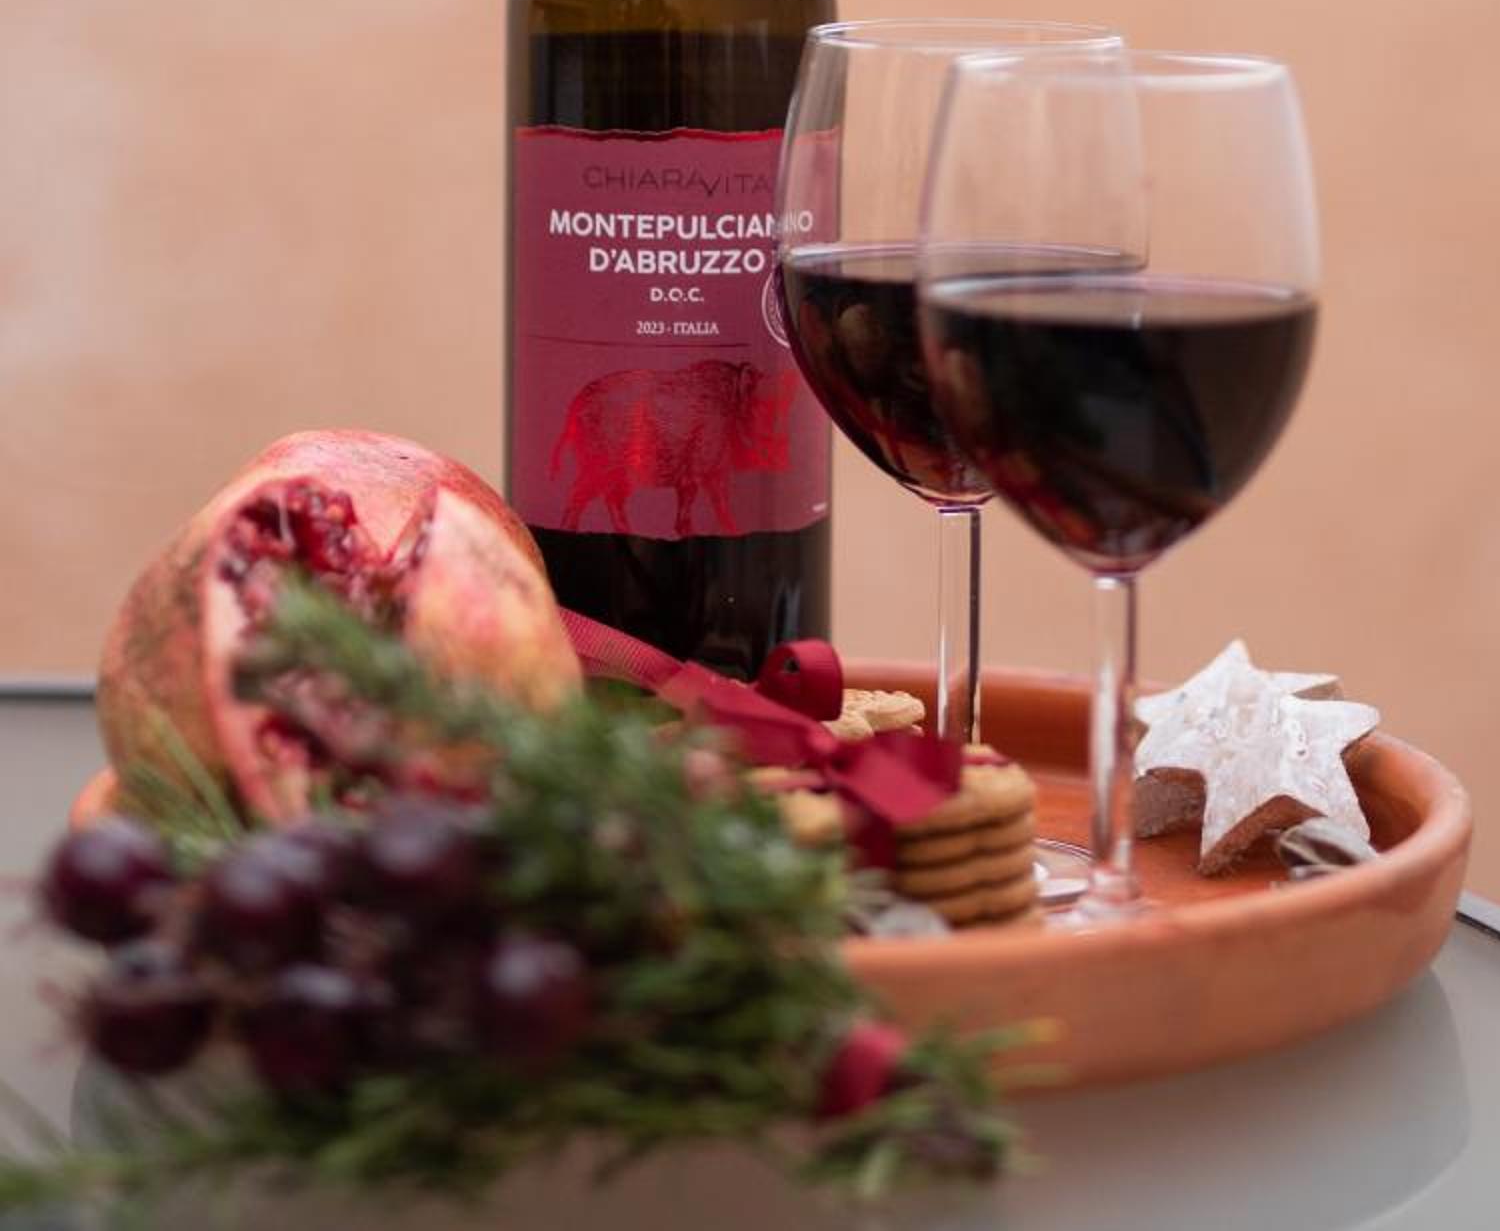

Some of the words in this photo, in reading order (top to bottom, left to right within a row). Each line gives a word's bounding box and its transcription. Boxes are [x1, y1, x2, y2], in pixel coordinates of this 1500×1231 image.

[582, 166, 772, 196] CHIARAVITA
[589, 247, 764, 274] D'ABRUZZO
[650, 287, 704, 302] D.O.C.
[636, 321, 665, 335] 2023
[673, 321, 719, 335] ITALIA
